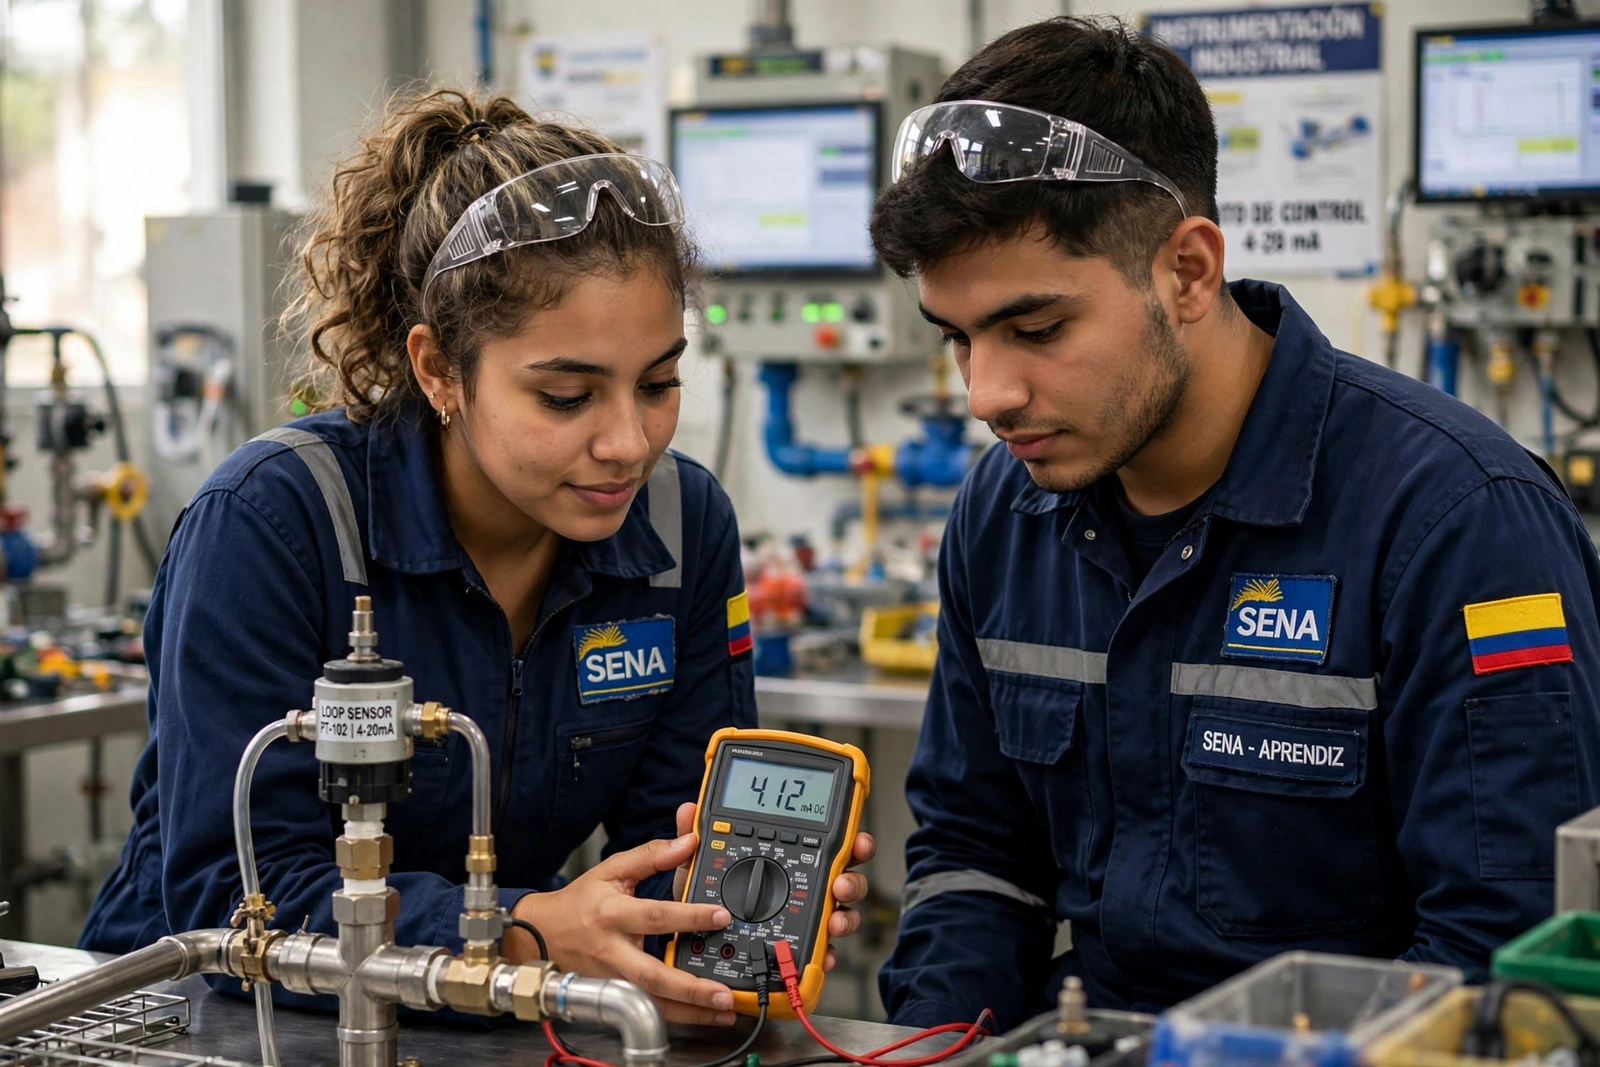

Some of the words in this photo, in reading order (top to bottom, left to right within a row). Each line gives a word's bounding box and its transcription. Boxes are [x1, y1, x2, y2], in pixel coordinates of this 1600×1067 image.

[1191, 42, 1323, 75] INDUSTRIAL
[1252, 200, 1273, 224] DE
[1280, 200, 1367, 224] CONTROL
[1291, 229, 1322, 252] mA
[1236, 606, 1320, 641] SENA
[585, 646, 667, 683] SENA
[320, 721, 348, 737] PT-102
[356, 723, 395, 737] 4-20mA
[321, 705, 345, 719] LOOP
[347, 705, 393, 720] SENSOR
[1202, 730, 1244, 756] SENA
[1258, 739, 1344, 767] APRENDIZ
[750, 775, 806, 812] 4.12
[800, 803, 812, 814] mA
[814, 804, 825, 815] DC
